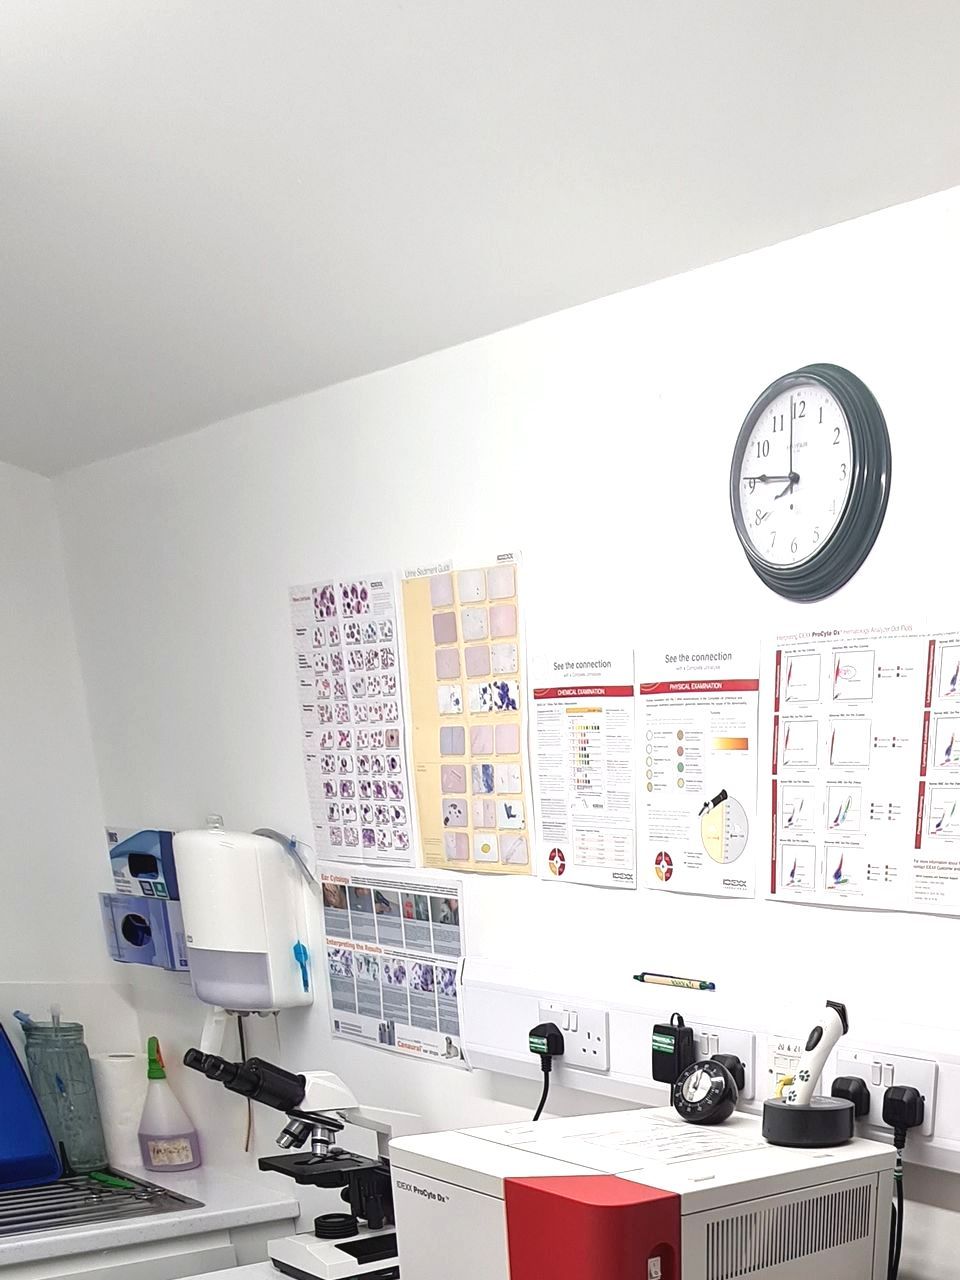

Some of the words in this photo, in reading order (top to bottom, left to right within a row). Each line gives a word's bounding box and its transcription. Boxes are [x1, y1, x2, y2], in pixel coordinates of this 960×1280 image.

[793, 400, 806, 419] 12
[818, 407, 824, 424] 1
[772, 414, 784, 432] 11
[833, 427, 840, 445] 2
[756, 440, 770, 458] 10
[840, 464, 847, 480] 3
[755, 509, 762, 526] 8
[770, 531, 776, 548] 7
[812, 526, 820, 544] 5
[790, 536, 798, 554] 6
[554, 662, 564, 670] See
[576, 660, 611, 669] connection
[665, 654, 677, 663] See
[679, 654, 689, 662] the
[692, 652, 732, 662] connection
[691, 682, 722, 690] EXAMINATION
[413, 1186, 436, 1200] ProCyte
